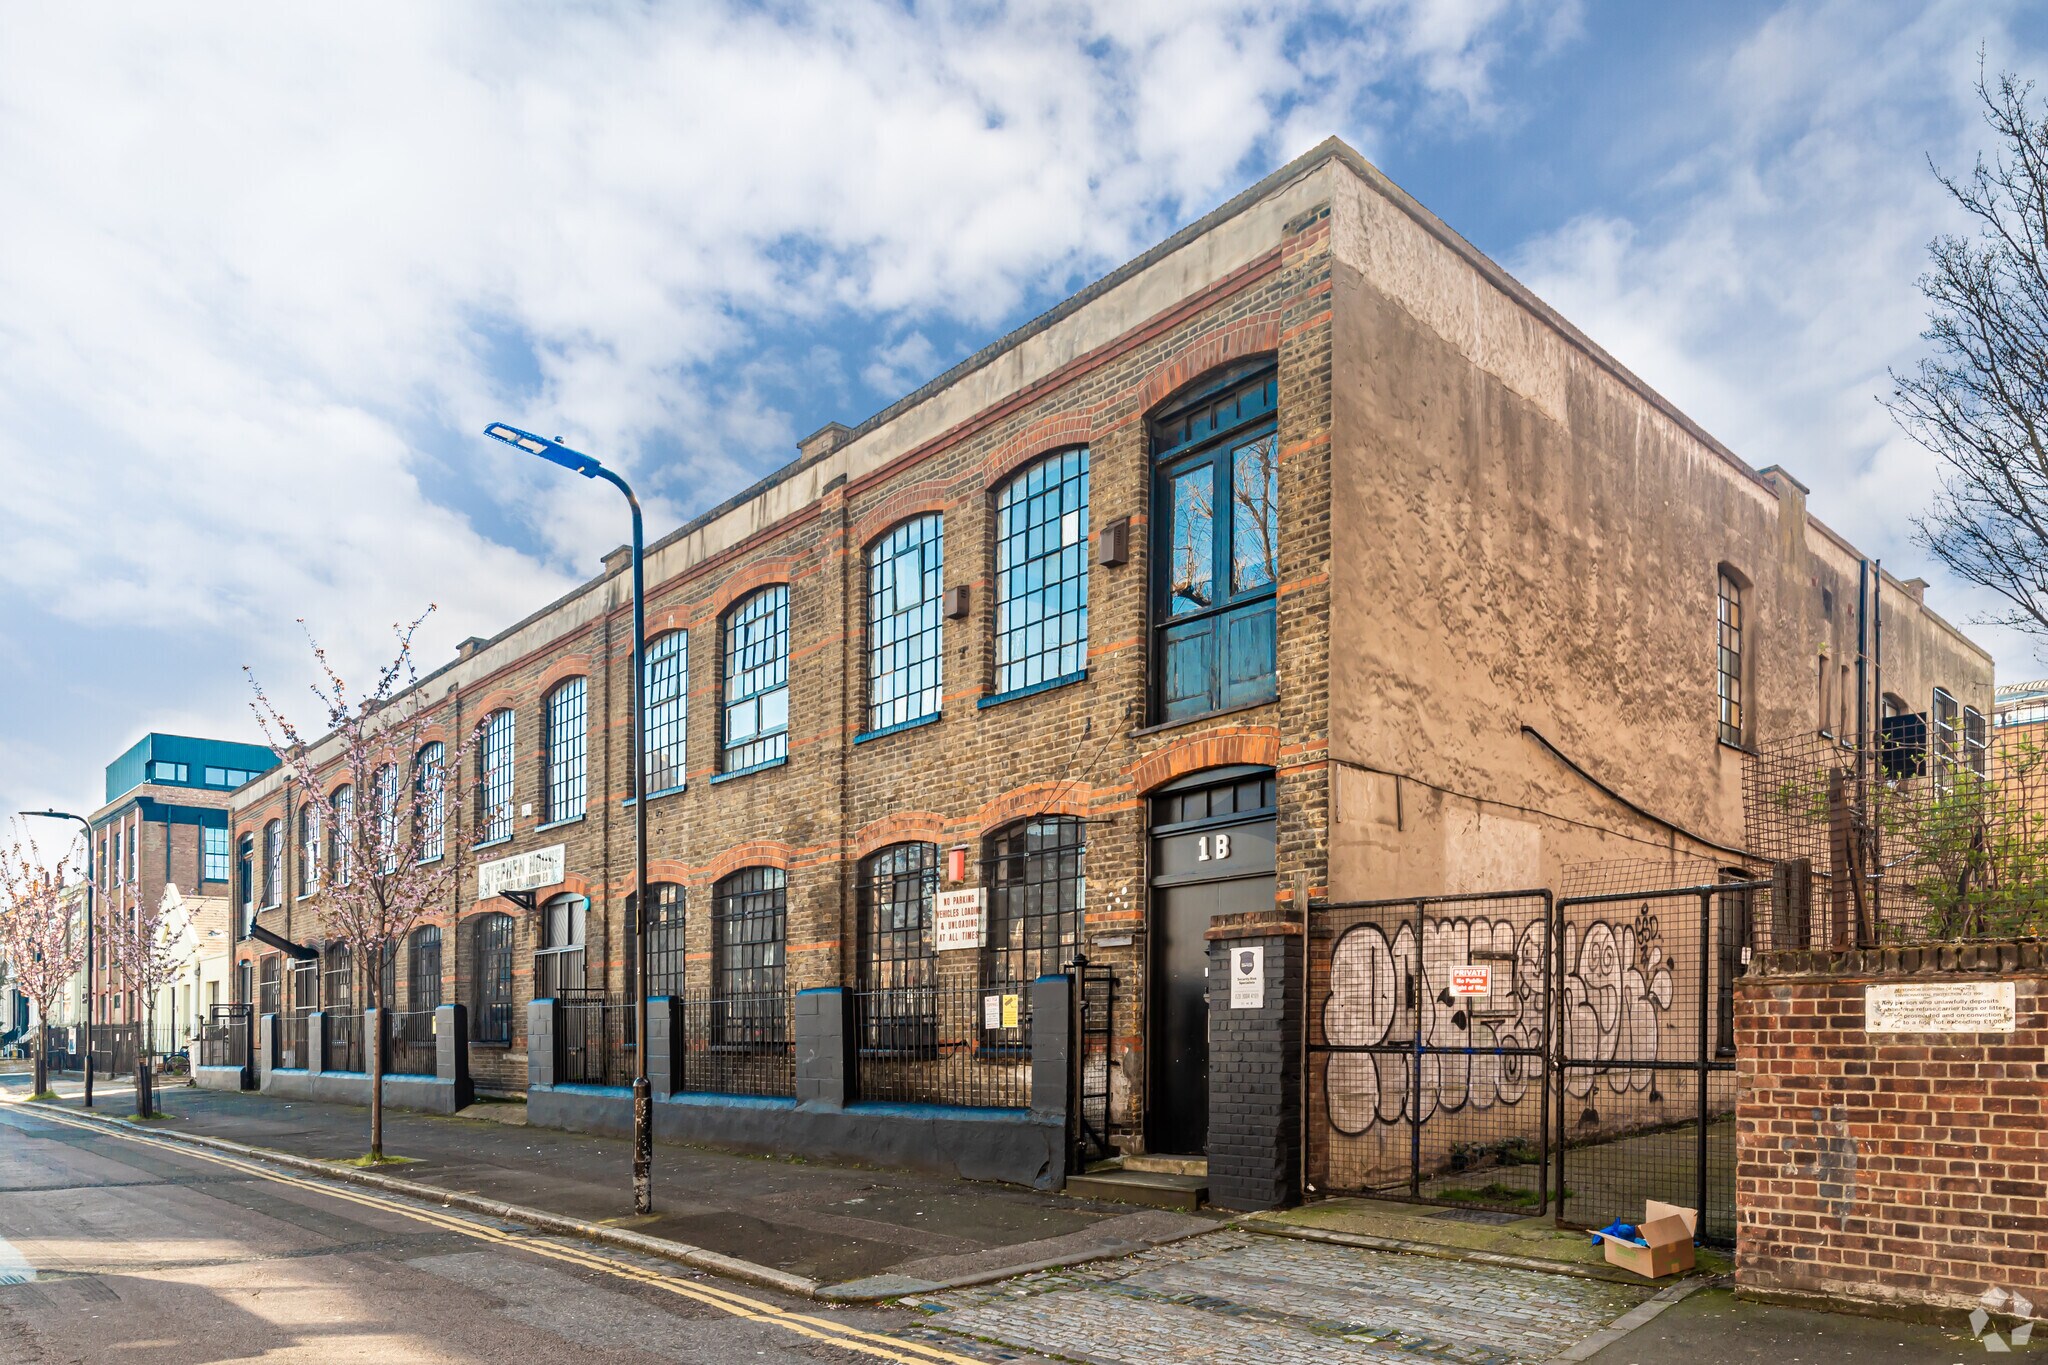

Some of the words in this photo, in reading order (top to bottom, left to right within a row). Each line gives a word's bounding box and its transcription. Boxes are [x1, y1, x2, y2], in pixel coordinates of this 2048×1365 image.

[1199, 834, 1231, 861] 1B
[944, 897, 950, 906] NO
[953, 895, 975, 905] PARKING
[936, 909, 959, 919] VEHICLES
[962, 906, 982, 916] LOADING
[941, 922, 945, 930] &
[948, 919, 978, 930] UNLOADING
[939, 934, 946, 942] AT
[949, 932, 959, 942] ALL
[962, 931, 979, 941] TIMES
[1454, 969, 1487, 977] PRIVATE
